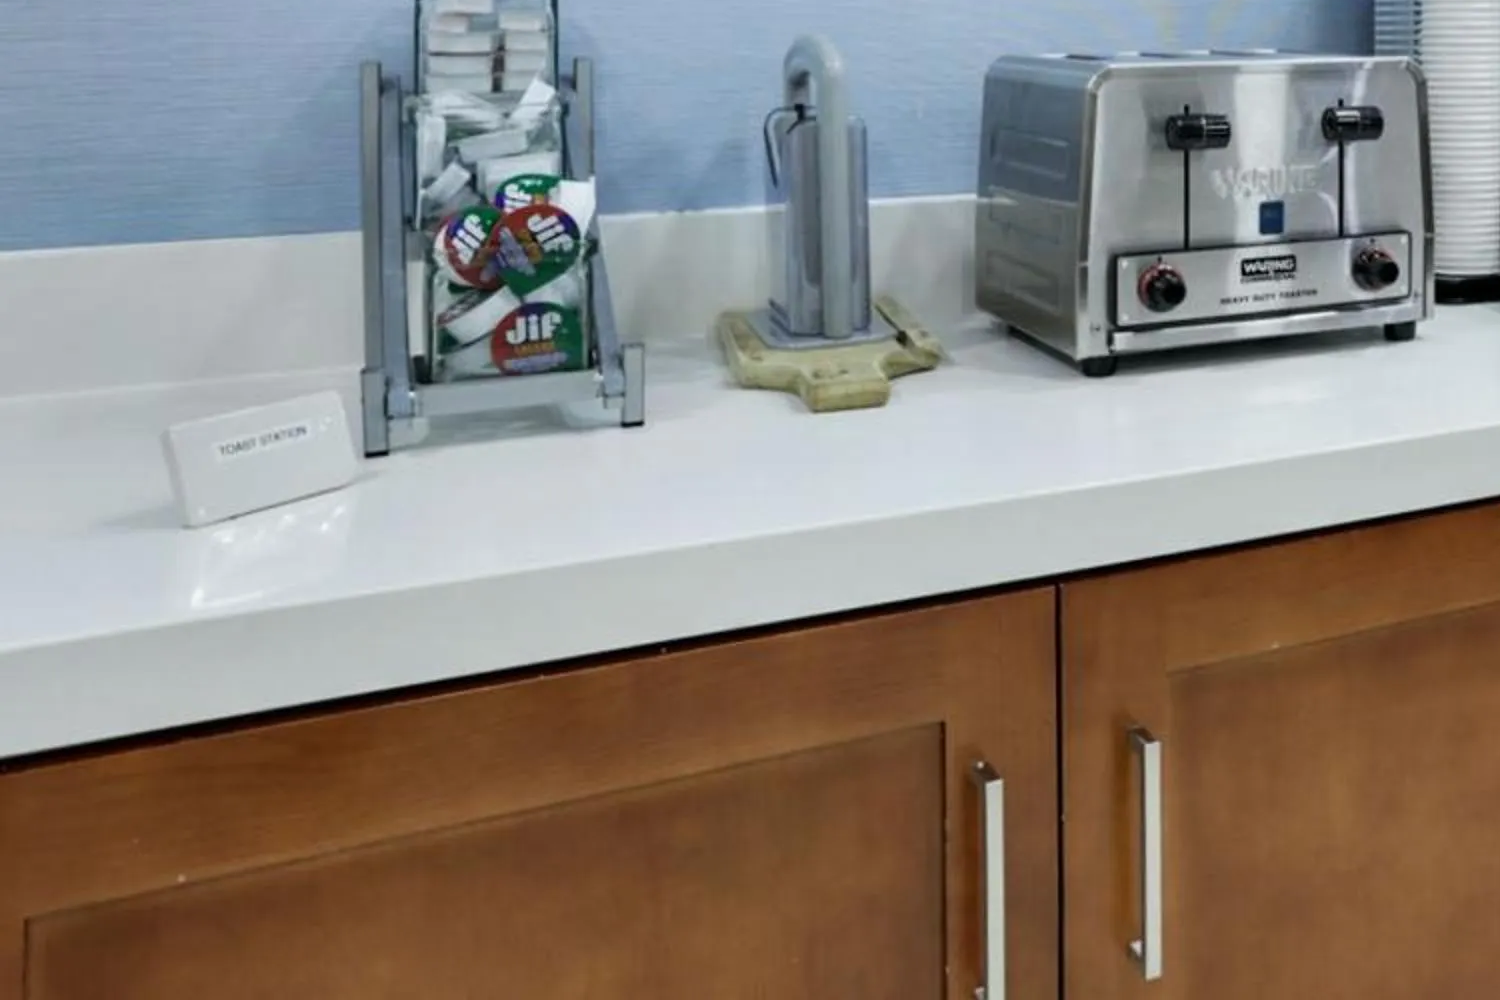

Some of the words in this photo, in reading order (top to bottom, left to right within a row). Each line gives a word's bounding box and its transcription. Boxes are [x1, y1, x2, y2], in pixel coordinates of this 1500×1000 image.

[503, 183, 532, 213] if
[527, 213, 575, 253] Jif
[506, 311, 562, 345] Jif
